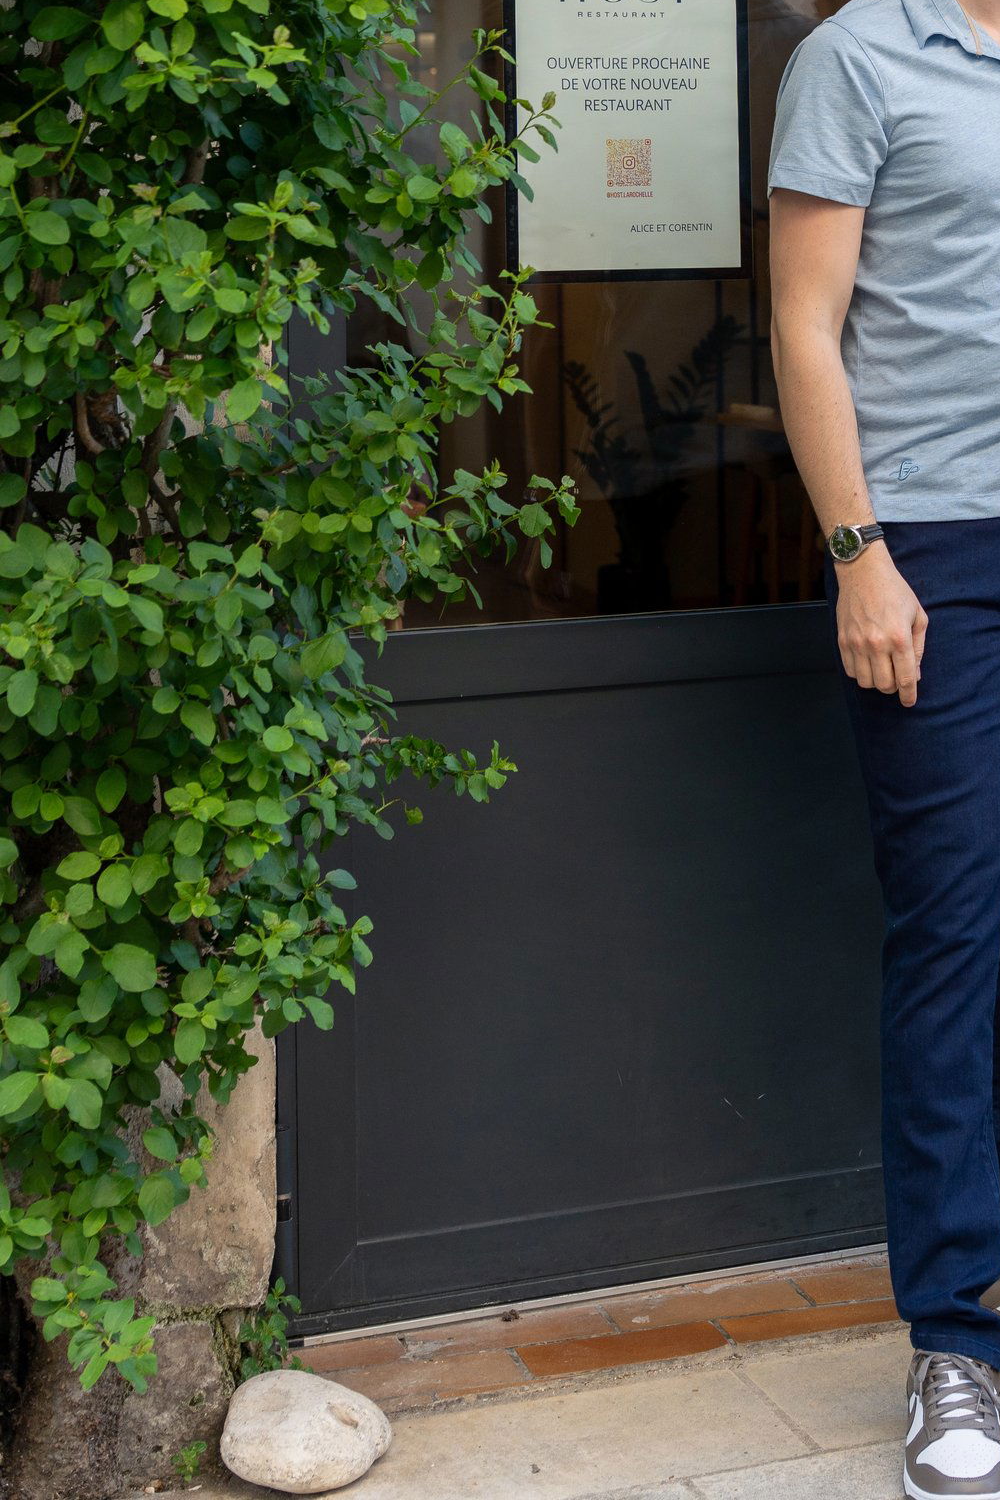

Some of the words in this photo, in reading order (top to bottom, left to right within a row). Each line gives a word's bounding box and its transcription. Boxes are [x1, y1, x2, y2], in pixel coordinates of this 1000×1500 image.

[547, 57, 628, 70] OUVERTURE
[632, 57, 711, 70] PROCHAINE
[561, 78, 579, 90] DE
[582, 78, 626, 90] VOTRE
[630, 78, 698, 90] NOUVEAU
[584, 99, 672, 111] RESTAURANT
[630, 224, 654, 233] ALICE
[656, 224, 666, 232] ET
[668, 223, 713, 232] CORENTIN
